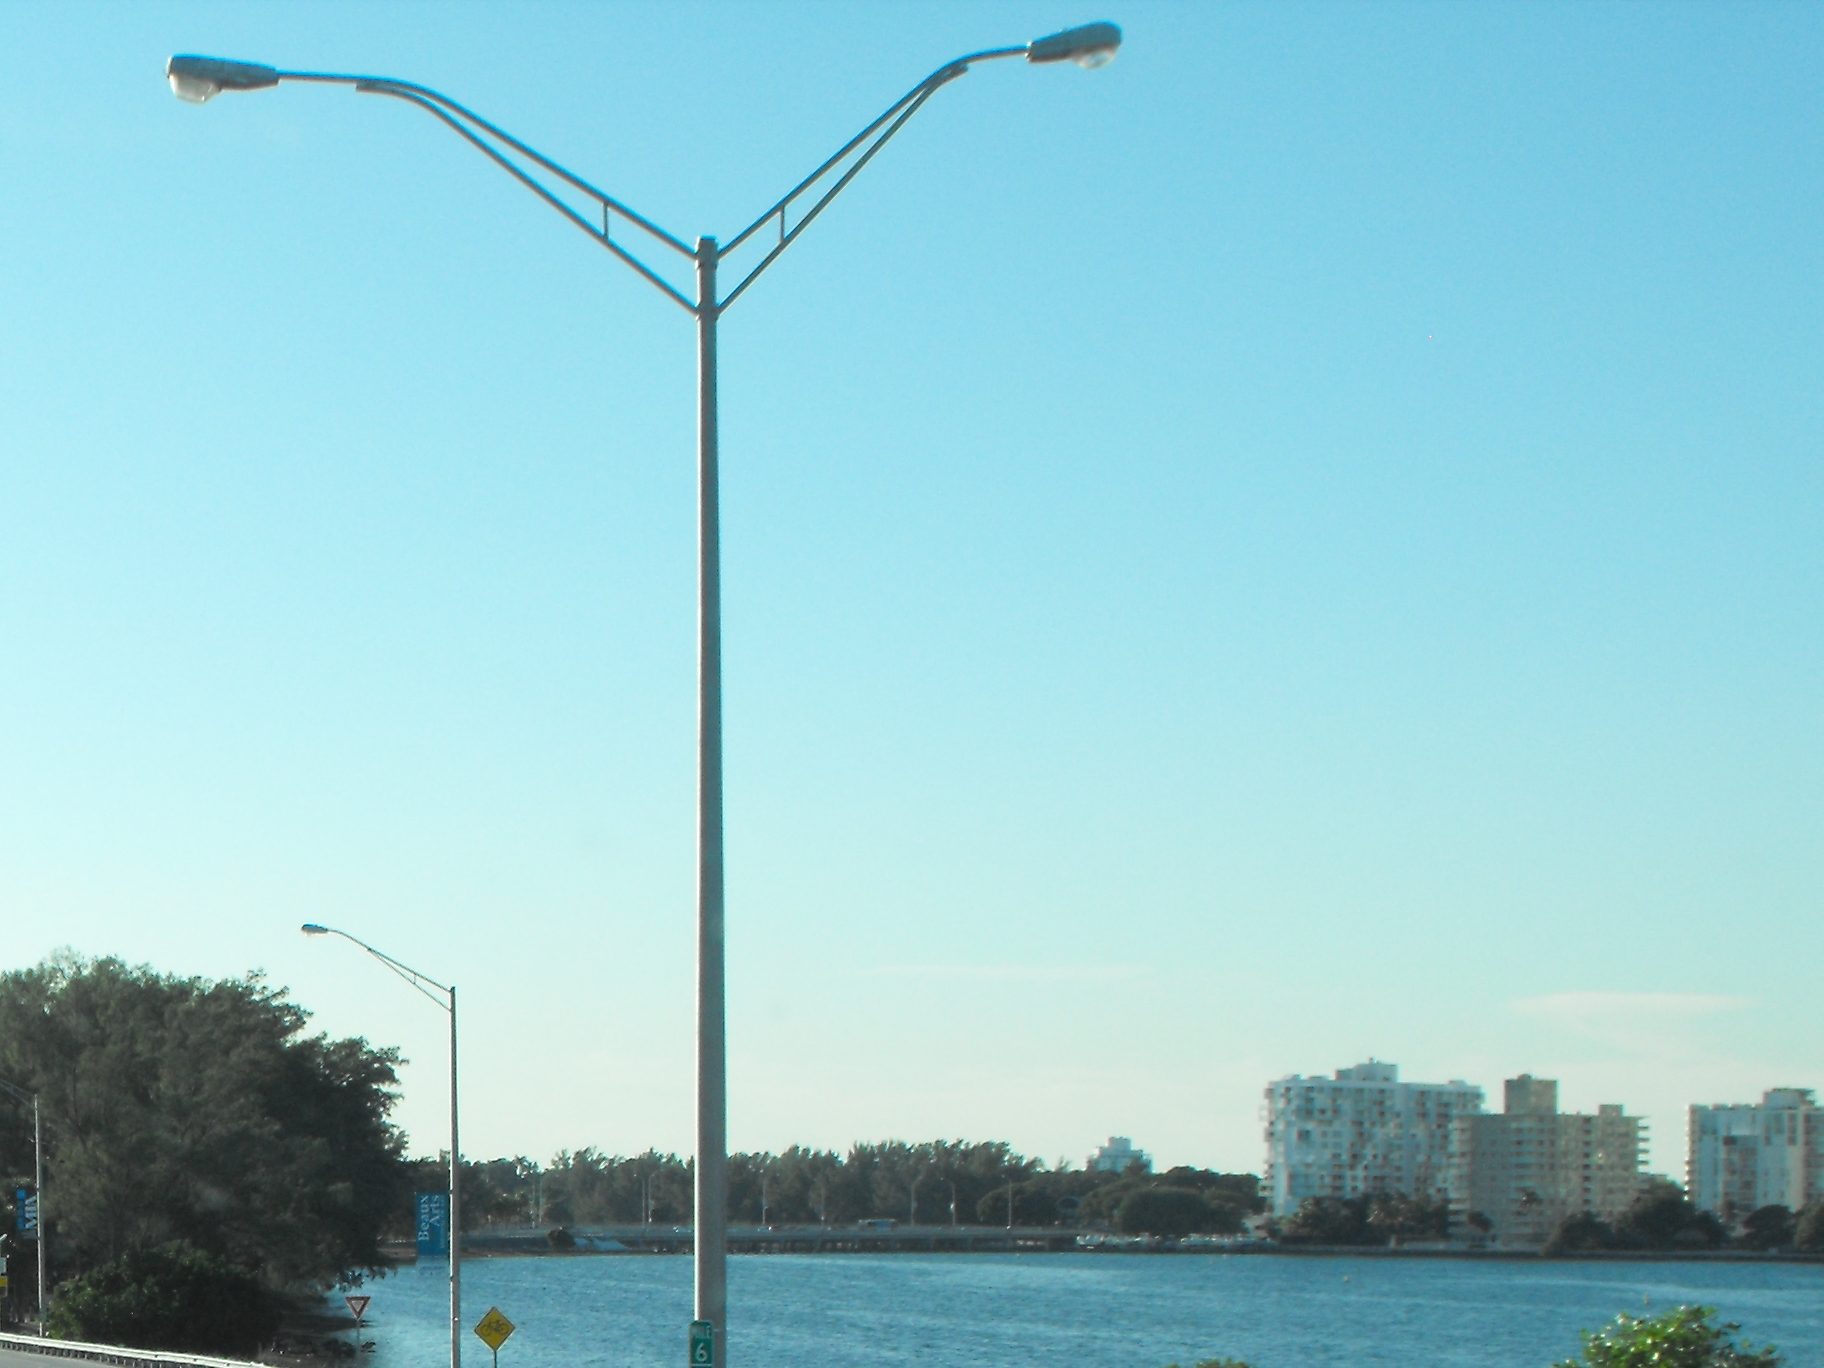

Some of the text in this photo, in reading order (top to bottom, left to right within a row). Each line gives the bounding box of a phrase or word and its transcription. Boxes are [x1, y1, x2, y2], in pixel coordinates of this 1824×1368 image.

[417, 1195, 430, 1241] Beaux
[429, 1195, 440, 1227] Arts
[695, 1342, 708, 1362] 6
